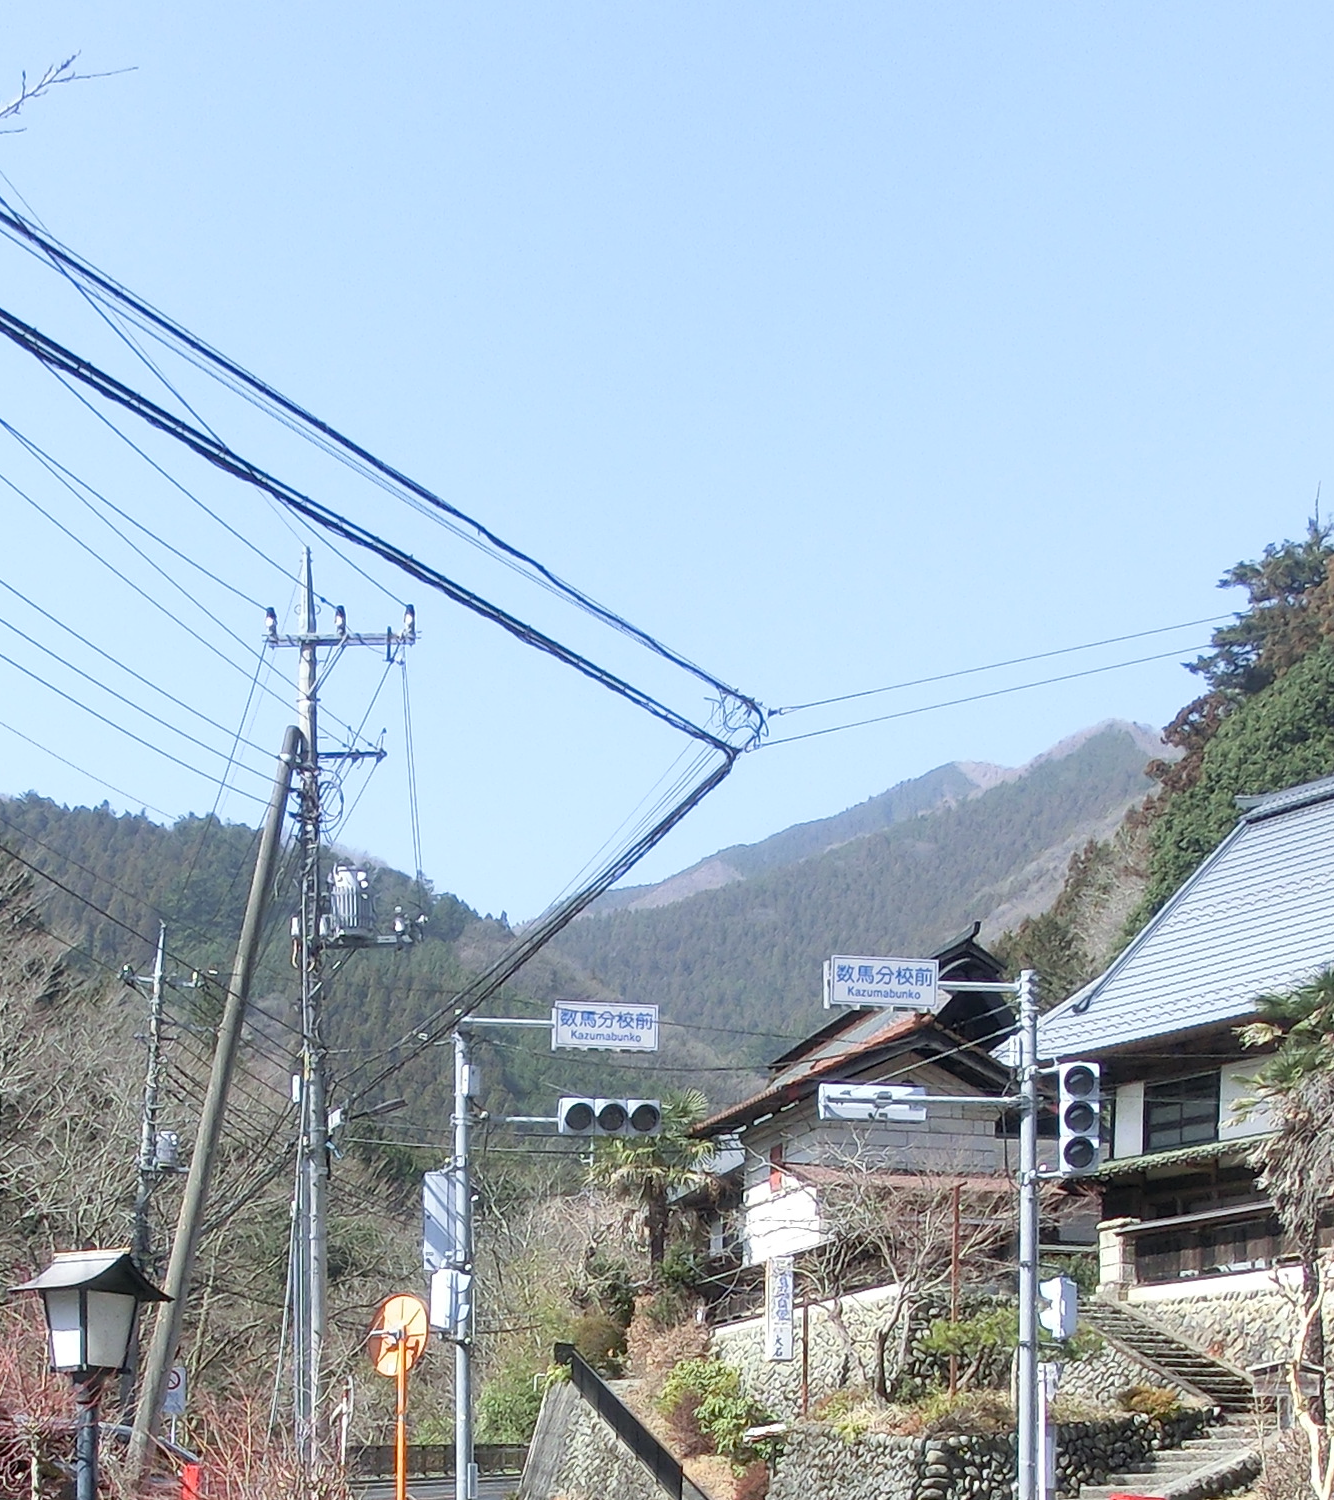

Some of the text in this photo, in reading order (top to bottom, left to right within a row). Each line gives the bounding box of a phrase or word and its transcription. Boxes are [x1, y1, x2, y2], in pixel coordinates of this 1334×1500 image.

[836, 965, 933, 987] 数馬分校前
[847, 986, 921, 1000] Kazumabunko
[560, 1009, 653, 1030] 数馬分校前
[570, 1029, 641, 1042] Kazumabunko
